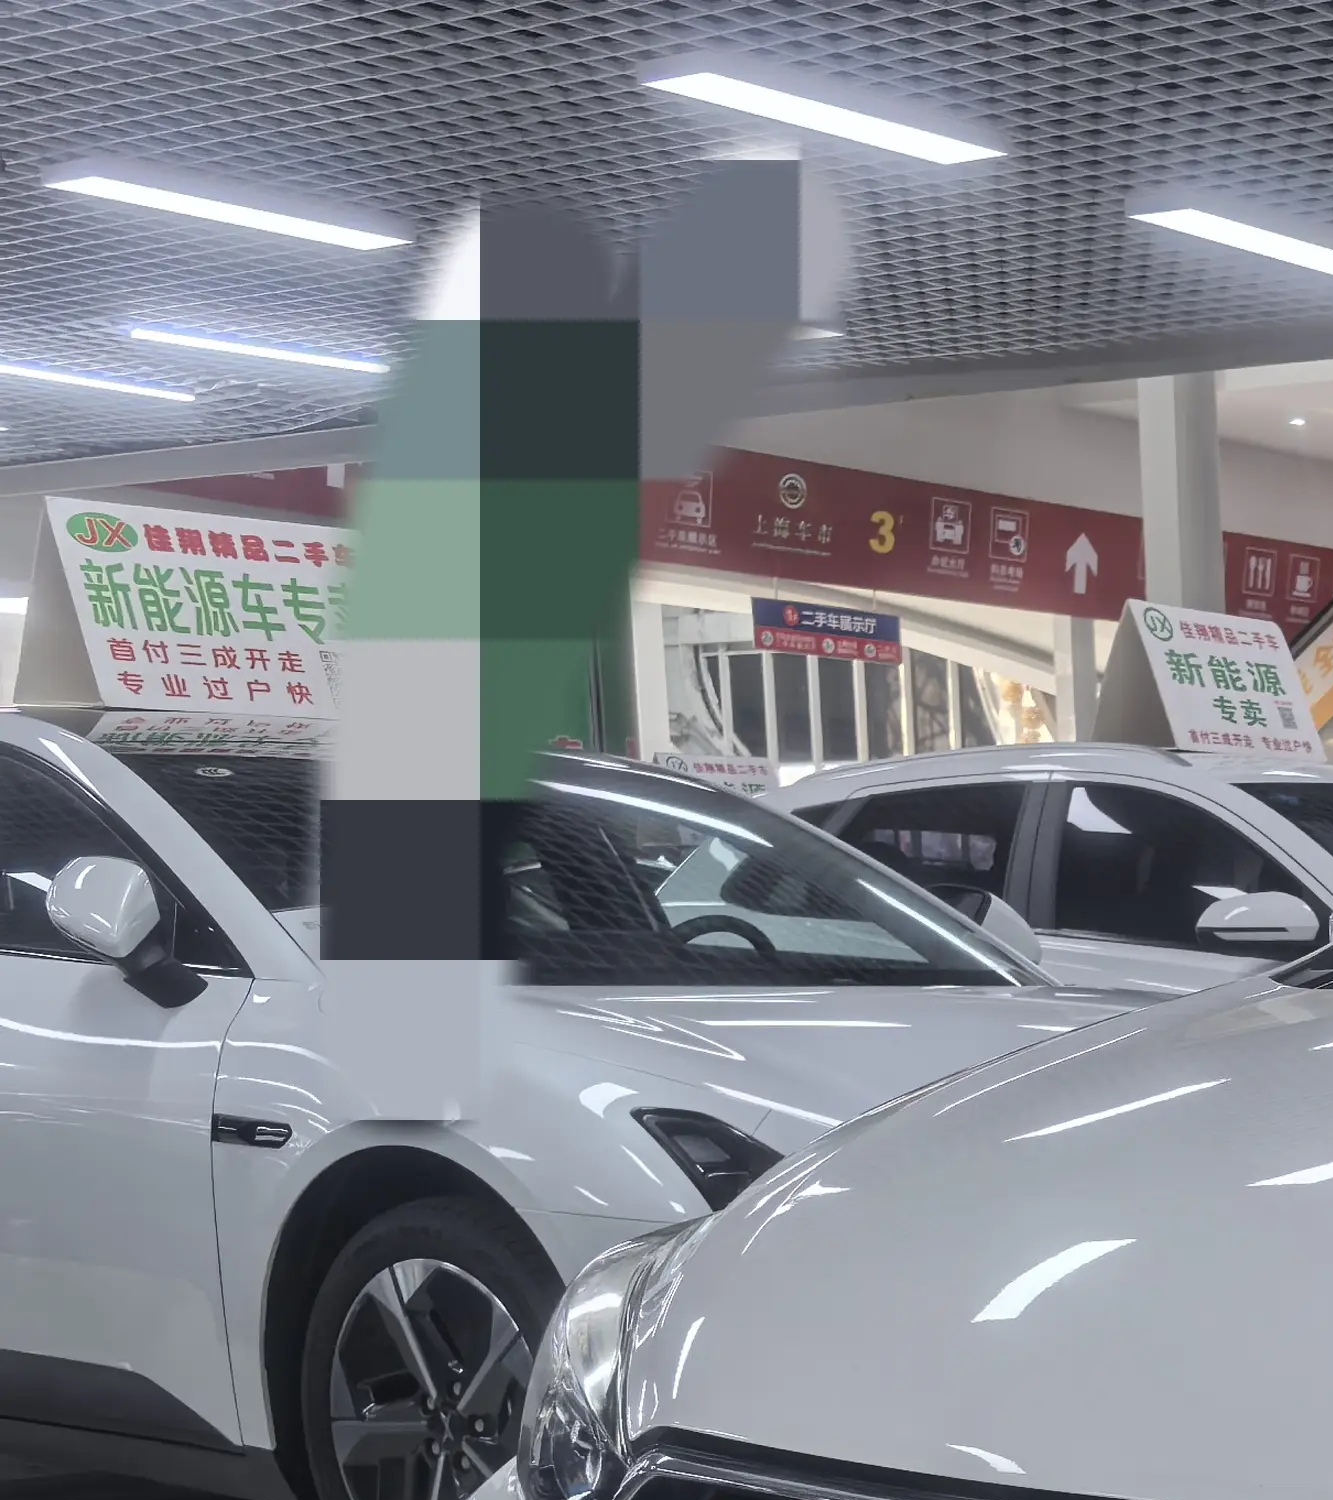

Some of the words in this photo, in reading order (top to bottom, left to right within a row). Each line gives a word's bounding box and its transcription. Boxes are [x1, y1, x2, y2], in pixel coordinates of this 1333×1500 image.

[75, 516, 132, 549] JX
[801, 609, 878, 635] 二手车展示厅
[106, 637, 306, 673] 首付三成开走
[116, 670, 315, 705] 专业过户快
[1164, 649, 1287, 697] 新能源
[1213, 695, 1268, 728] 专卖
